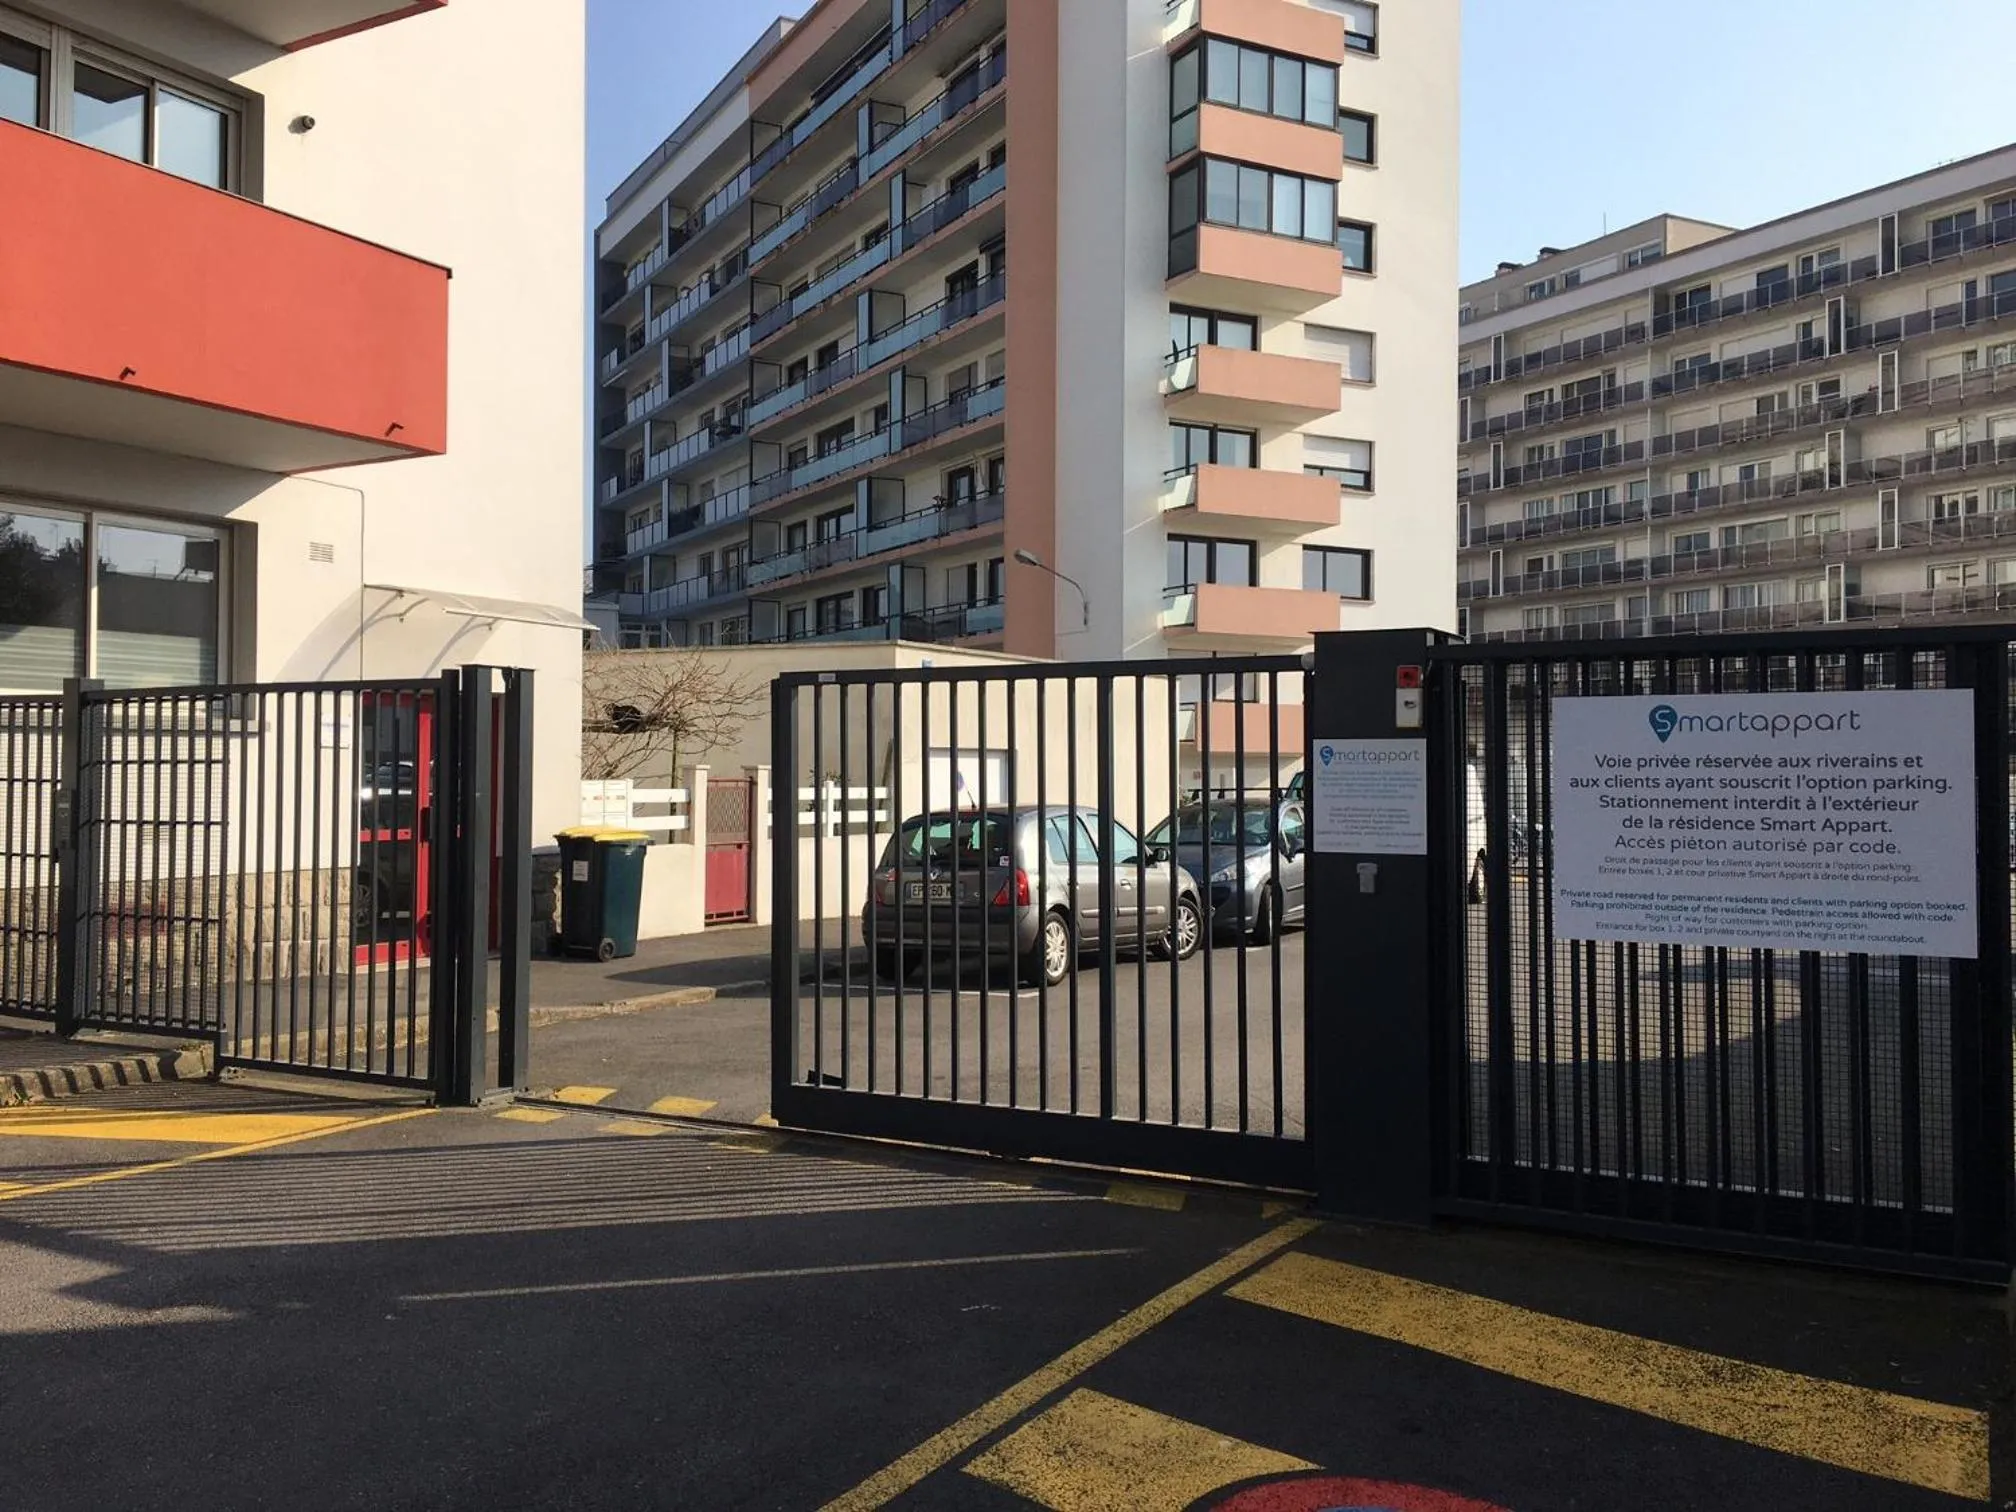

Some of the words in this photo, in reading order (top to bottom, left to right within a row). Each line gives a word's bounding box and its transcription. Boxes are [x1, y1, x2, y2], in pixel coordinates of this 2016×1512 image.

[1652, 706, 1861, 740] Smartappart
[1595, 754, 1632, 768] Voie
[1637, 754, 1690, 771] privée
[1696, 754, 1772, 768] réservée
[1777, 756, 1811, 768] aux
[1817, 753, 1898, 768] riverains
[1903, 755, 1924, 768] et
[1569, 777, 1600, 788] aux
[1604, 774, 1661, 788] clients
[1665, 776, 1714, 792] ayant
[1719, 775, 1791, 789] souscrit
[1796, 775, 1867, 793] l'option
[1873, 775, 1952, 793] parking.
[1599, 795, 1728, 809] Stationnement
[1734, 796, 1801, 810] interdit
[1806, 797, 1816, 810] à
[1822, 796, 1919, 811] l'extérieur
[1622, 815, 1643, 829] de
[1649, 815, 1663, 829] la
[1669, 815, 1755, 831] résidence
[1760, 817, 1816, 832] Smart
[1821, 818, 1893, 836] Appart.
[1615, 835, 1665, 849] Accès
[1671, 836, 1727, 853] piéton
[1732, 838, 1807, 852] autorisé
[1813, 841, 1844, 856] par
[1849, 839, 1901, 854] code.
[1560, 889, 1591, 898] Private
[1592, 890, 1613, 898] road
[1615, 892, 1654, 900] reserved
[1656, 892, 1669, 901] for
[1671, 894, 1722, 904] permanent
[1725, 895, 1769, 904] residents
[1770, 896, 1789, 905] and
[1791, 897, 1823, 906] clients
[1826, 898, 1847, 907] with
[1849, 899, 1888, 910] parking
[1890, 901, 1923, 911] option
[1570, 900, 1604, 910] Parking
[1654, 902, 1688, 912] outside
[1691, 904, 1701, 912] of
[1703, 905, 1718, 913] the
[1826, 910, 1859, 918] access
[1861, 910, 1900, 920] allowed
[1903, 912, 1925, 921] with
